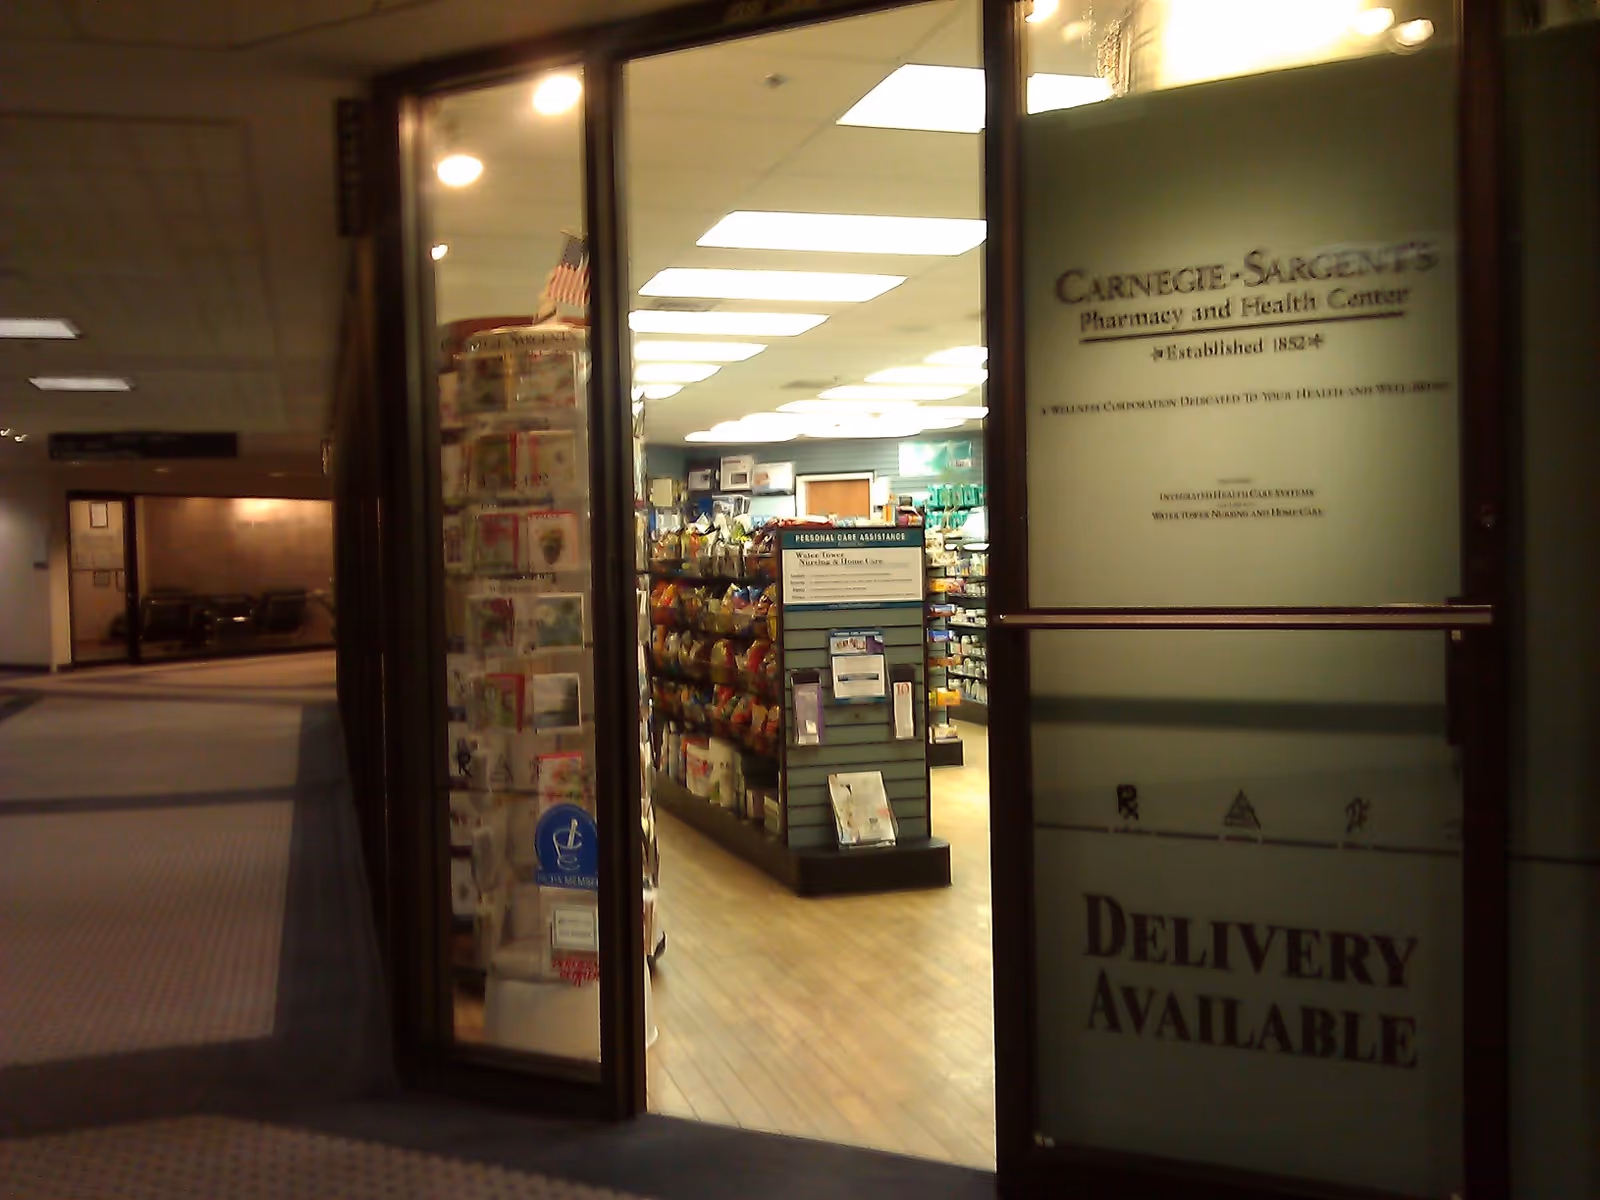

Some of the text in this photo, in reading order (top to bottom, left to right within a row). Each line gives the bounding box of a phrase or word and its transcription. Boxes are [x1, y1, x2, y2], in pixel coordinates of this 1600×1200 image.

[1079, 287, 1411, 332] Pharmacy and Health Center
[794, 532, 906, 543] PERSONAL CARE ASSISTANCE
[795, 551, 818, 559] Water
[799, 558, 830, 567] Nursing
[840, 557, 863, 565] Home
[1083, 893, 1418, 988] DELIVERY
[1087, 967, 1419, 1070] AVAILABLE
